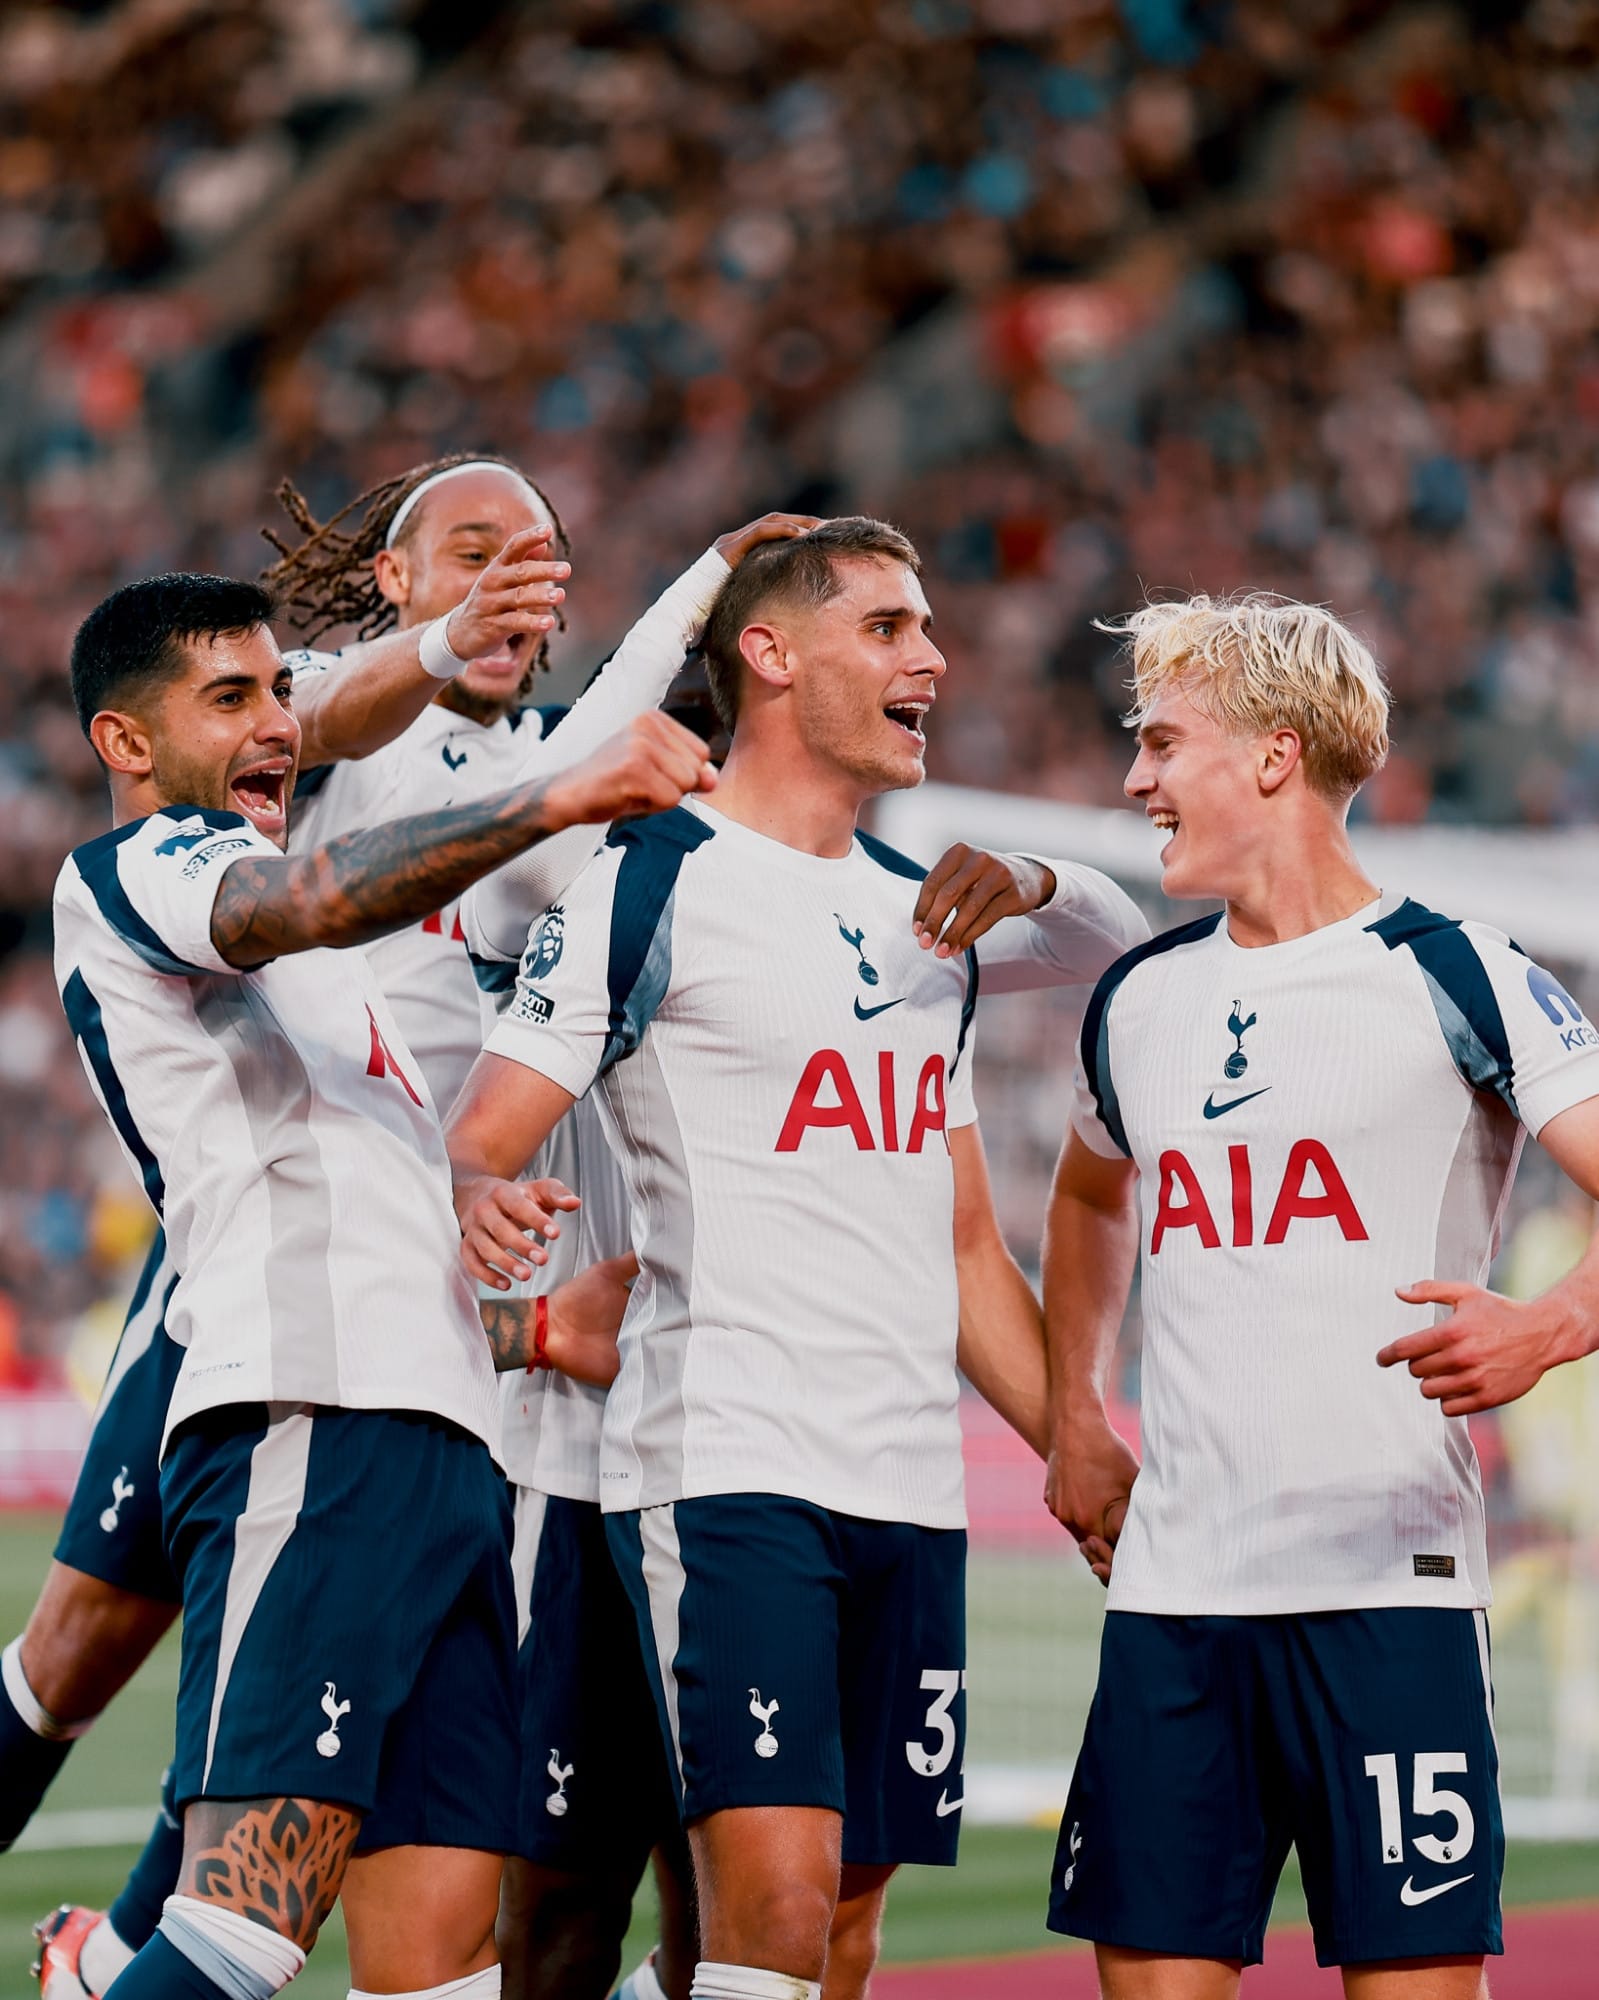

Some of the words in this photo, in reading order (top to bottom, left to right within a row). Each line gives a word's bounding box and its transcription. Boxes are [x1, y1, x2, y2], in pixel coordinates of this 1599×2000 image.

[774, 1049, 952, 1157] AIA
[1151, 1139, 1369, 1255] AIA
[905, 1669, 967, 1777] 3
[1363, 1752, 1475, 1864] 15
